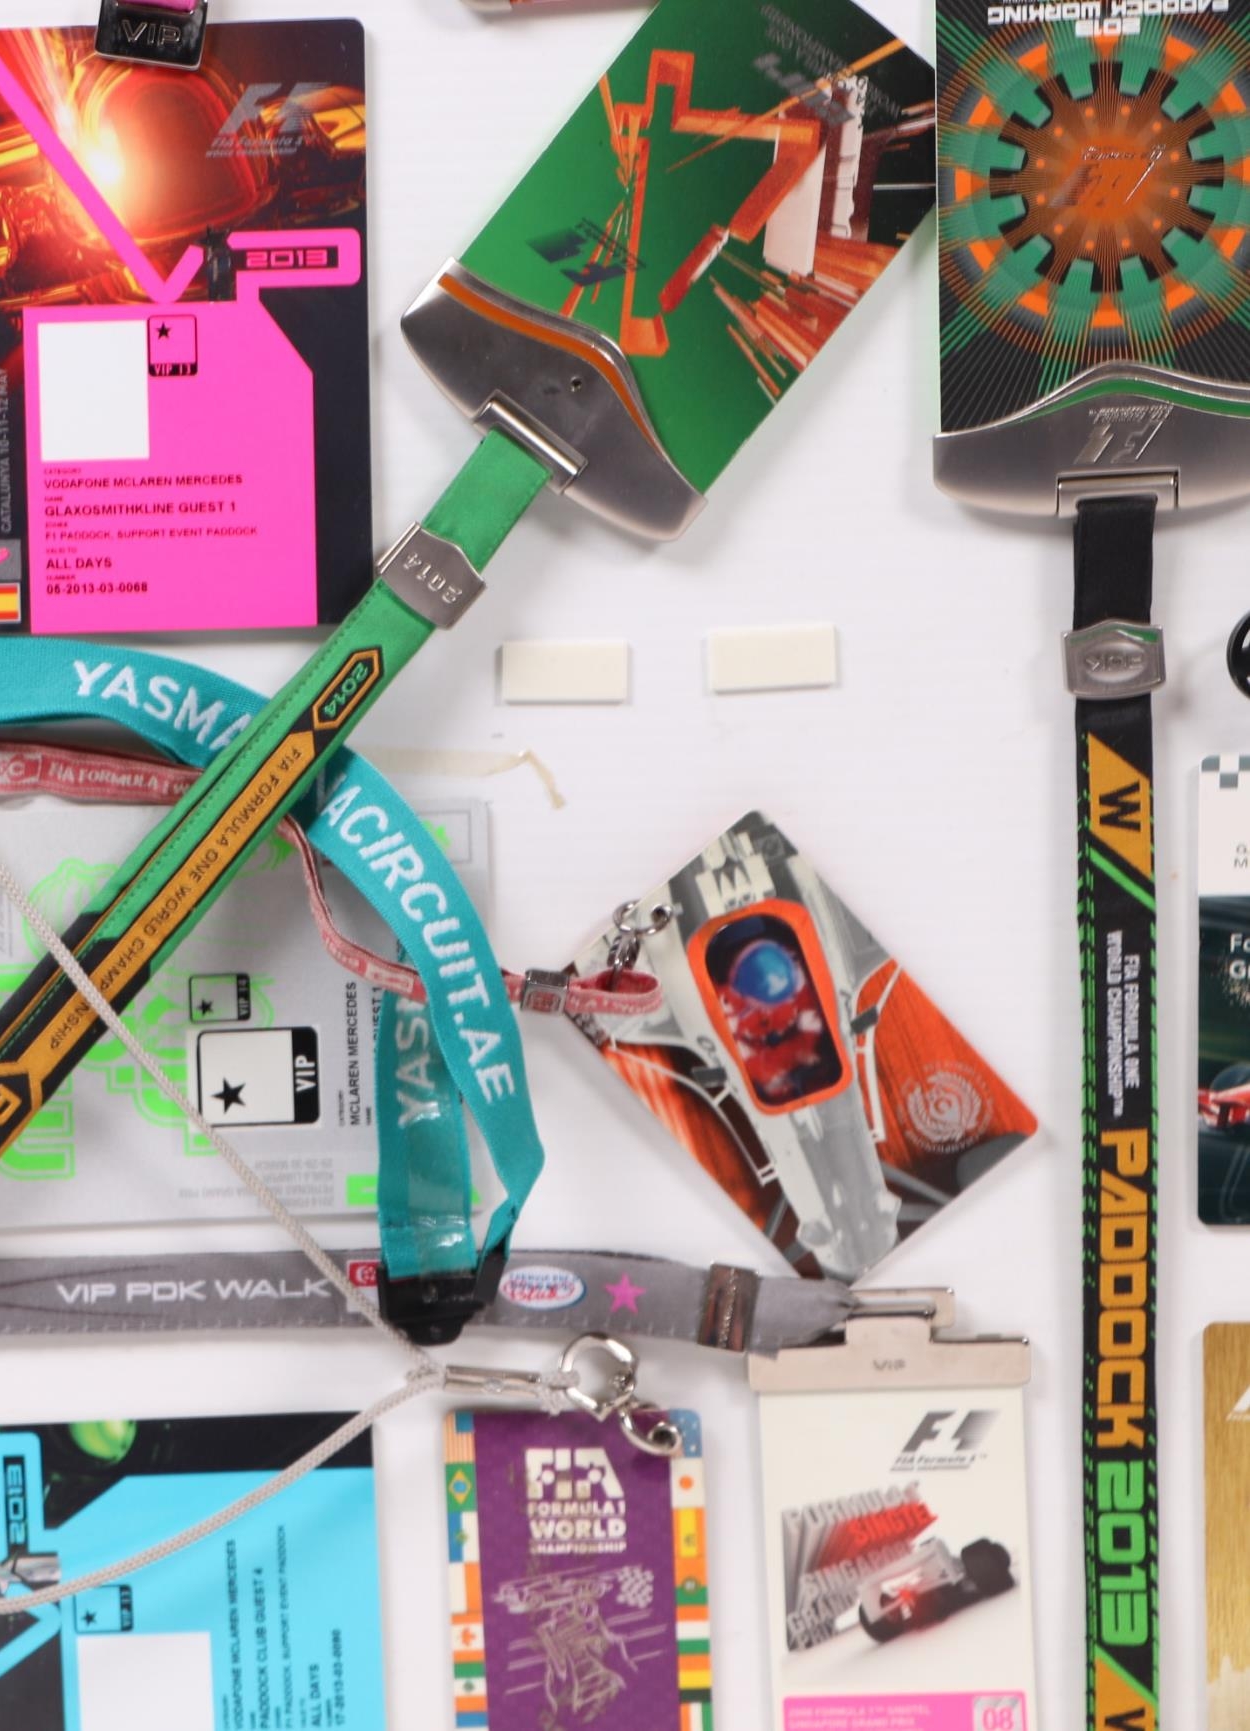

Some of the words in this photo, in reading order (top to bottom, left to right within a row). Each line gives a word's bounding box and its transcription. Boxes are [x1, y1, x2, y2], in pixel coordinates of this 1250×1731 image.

[121, 18, 183, 46] VIP
[988, 2, 1101, 25] WORKING
[245, 249, 329, 268] 2013
[0, 457, 12, 533] CATALUNYA
[44, 477, 110, 489] VODAFONE
[113, 476, 172, 487] MCLAREN
[175, 474, 243, 486] MERCEDES
[44, 502, 174, 518] GLAXOSMITHKLINE
[178, 501, 225, 514] GUEST
[117, 529, 165, 539] SUPPORT
[169, 527, 203, 538] EVENT
[206, 526, 258, 536] PADDOCK
[46, 558, 71, 570] ALL
[75, 557, 113, 569] DAYS
[403, 551, 464, 604] 2014
[324, 661, 369, 718] 2014
[279, 747, 302, 772] FIA
[78, 767, 158, 791] FORMULA
[219, 774, 280, 847] FORMULA
[1099, 780, 1141, 832] W
[189, 850, 219, 884] ONE
[143, 886, 191, 936] WORLD
[1107, 930, 1123, 985] WORLD
[1124, 954, 1140, 982] FIA
[50, 940, 145, 1051] CHAMPNSHIP
[345, 981, 358, 1056] MERCEDES
[1124, 983, 1140, 1056] FORMULA
[295, 1054, 316, 1093] VIP
[1125, 1057, 1140, 1089] ONE
[348, 1059, 360, 1126] MCLAREN
[57, 1282, 116, 1303] VIP
[126, 1280, 207, 1302] PDK
[214, 1278, 332, 1299] WALK
[1097, 1127, 1149, 1450] PADDOCK
[872, 1359, 906, 1372] VIP
[524, 1447, 625, 1499] FIA
[7, 1464, 27, 1546] 2013
[527, 1500, 616, 1518] FORMULA
[529, 1518, 627, 1540] WORLD
[529, 1541, 627, 1555] CHAMPIONSHIP
[226, 1538, 238, 1605] MERCEDES
[1097, 1460, 1149, 1646] 2013
[253, 1579, 266, 1623] GUEST
[229, 1607, 241, 1664] MCLAREN
[255, 1626, 268, 1662] CLUB
[231, 1667, 244, 1730] VODAFONE
[257, 1665, 270, 1729] PADDOCK
[308, 1663, 321, 1700] DAYS
[309, 1702, 323, 1727] ALL
[981, 1707, 1014, 1731] 08
